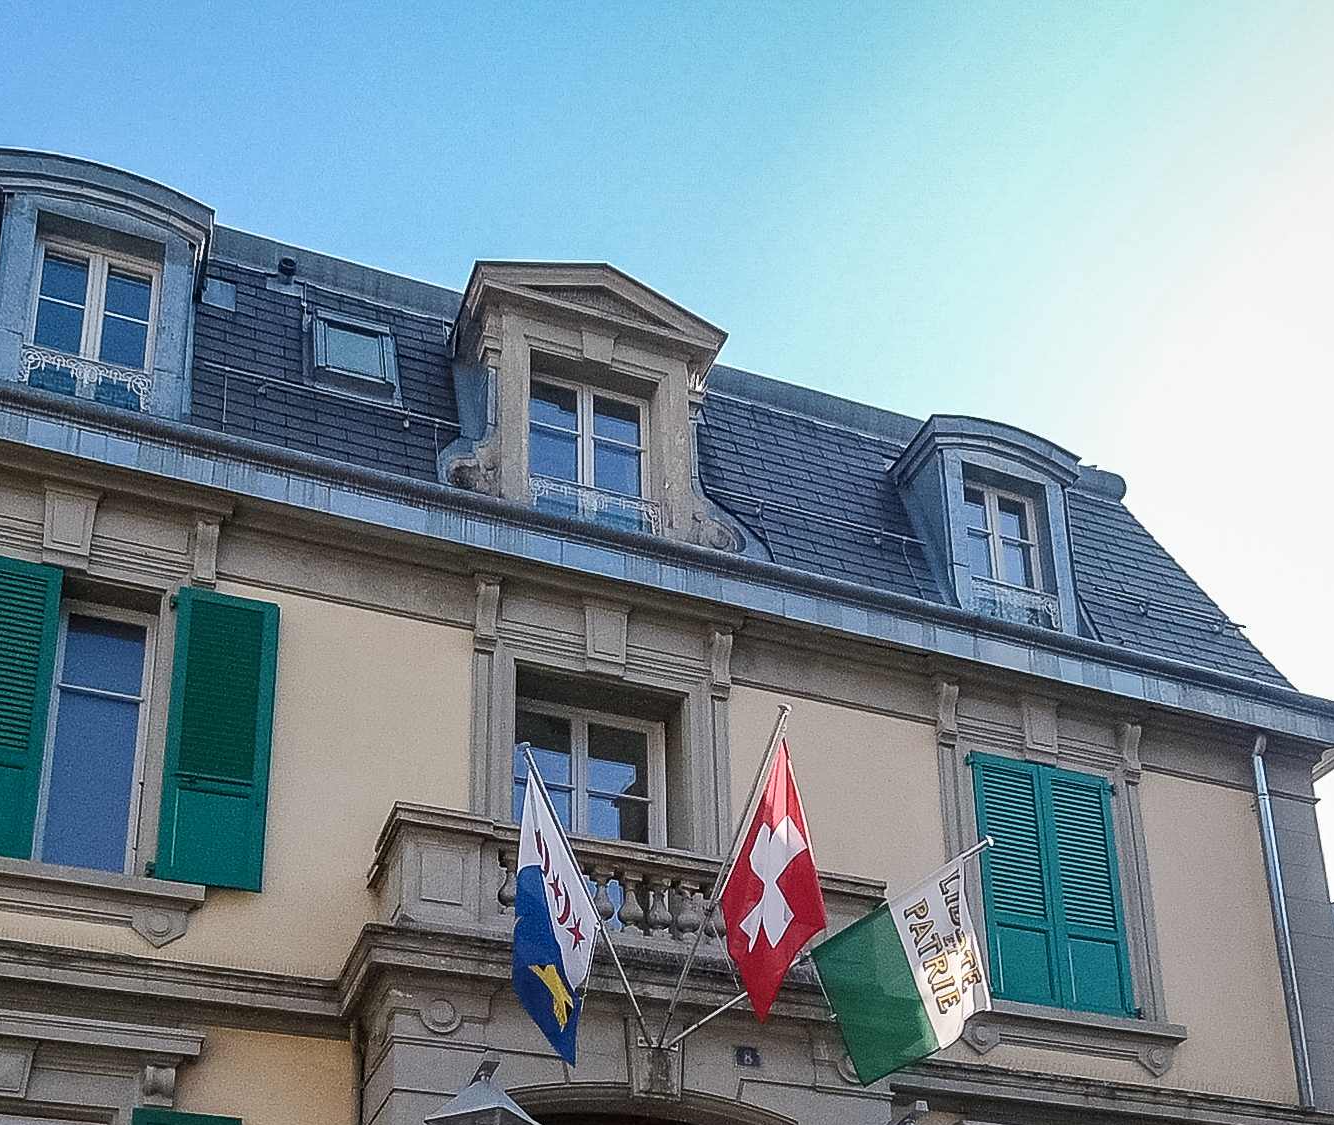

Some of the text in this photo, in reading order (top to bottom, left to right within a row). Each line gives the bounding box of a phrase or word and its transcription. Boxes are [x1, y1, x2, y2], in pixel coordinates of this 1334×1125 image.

[904, 898, 962, 1014] PATRIE
[938, 868, 982, 994] LIBRTE
[942, 934, 959, 956] ET
